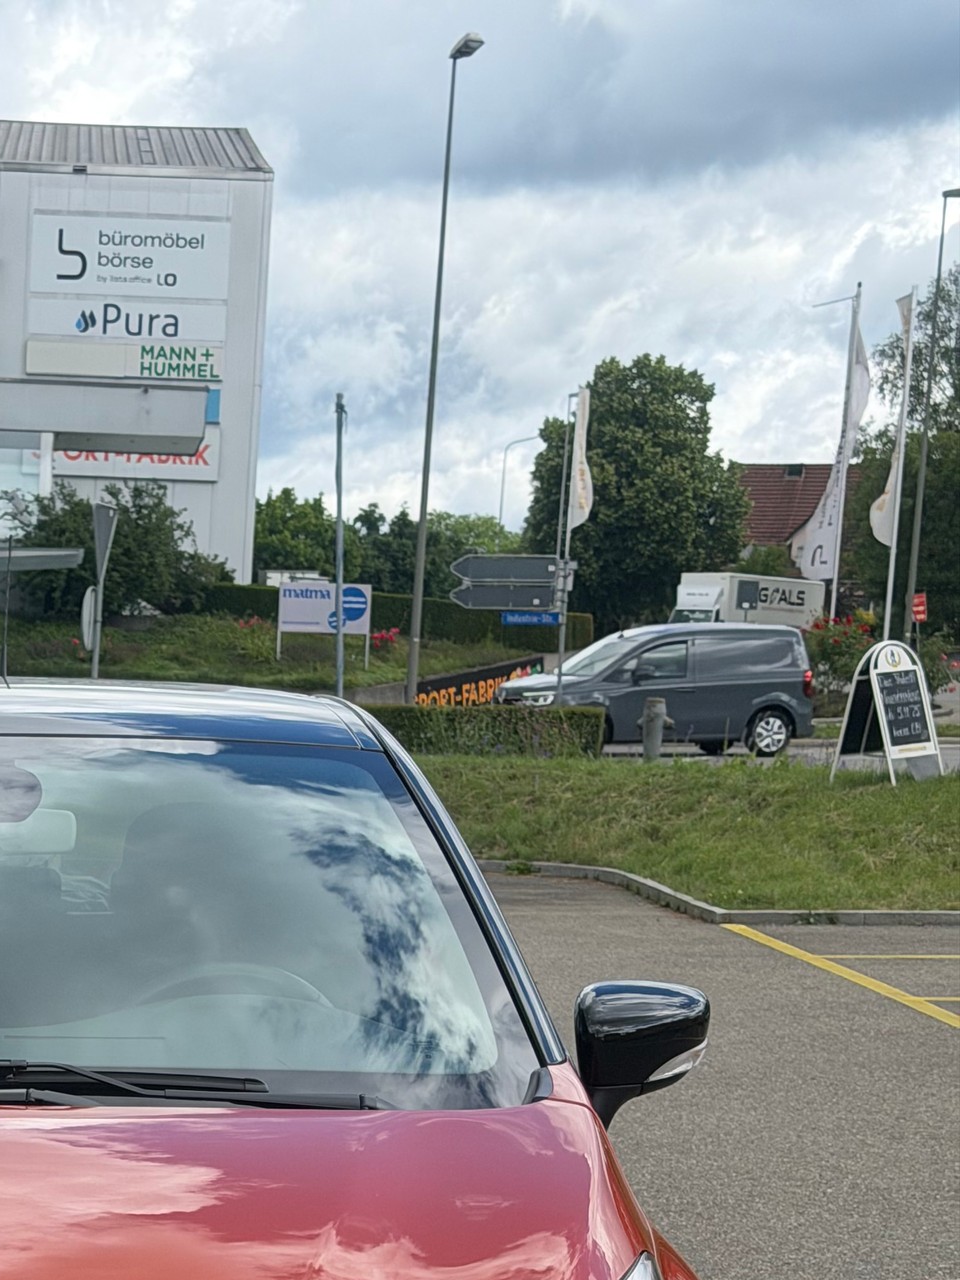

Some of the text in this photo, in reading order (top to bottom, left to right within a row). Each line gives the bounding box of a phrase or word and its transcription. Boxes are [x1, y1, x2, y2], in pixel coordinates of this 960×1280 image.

[98, 230, 205, 250] büromöbel
[97, 251, 154, 269] börse
[102, 303, 179, 337] Pura
[140, 362, 220, 378] HUMMEL
